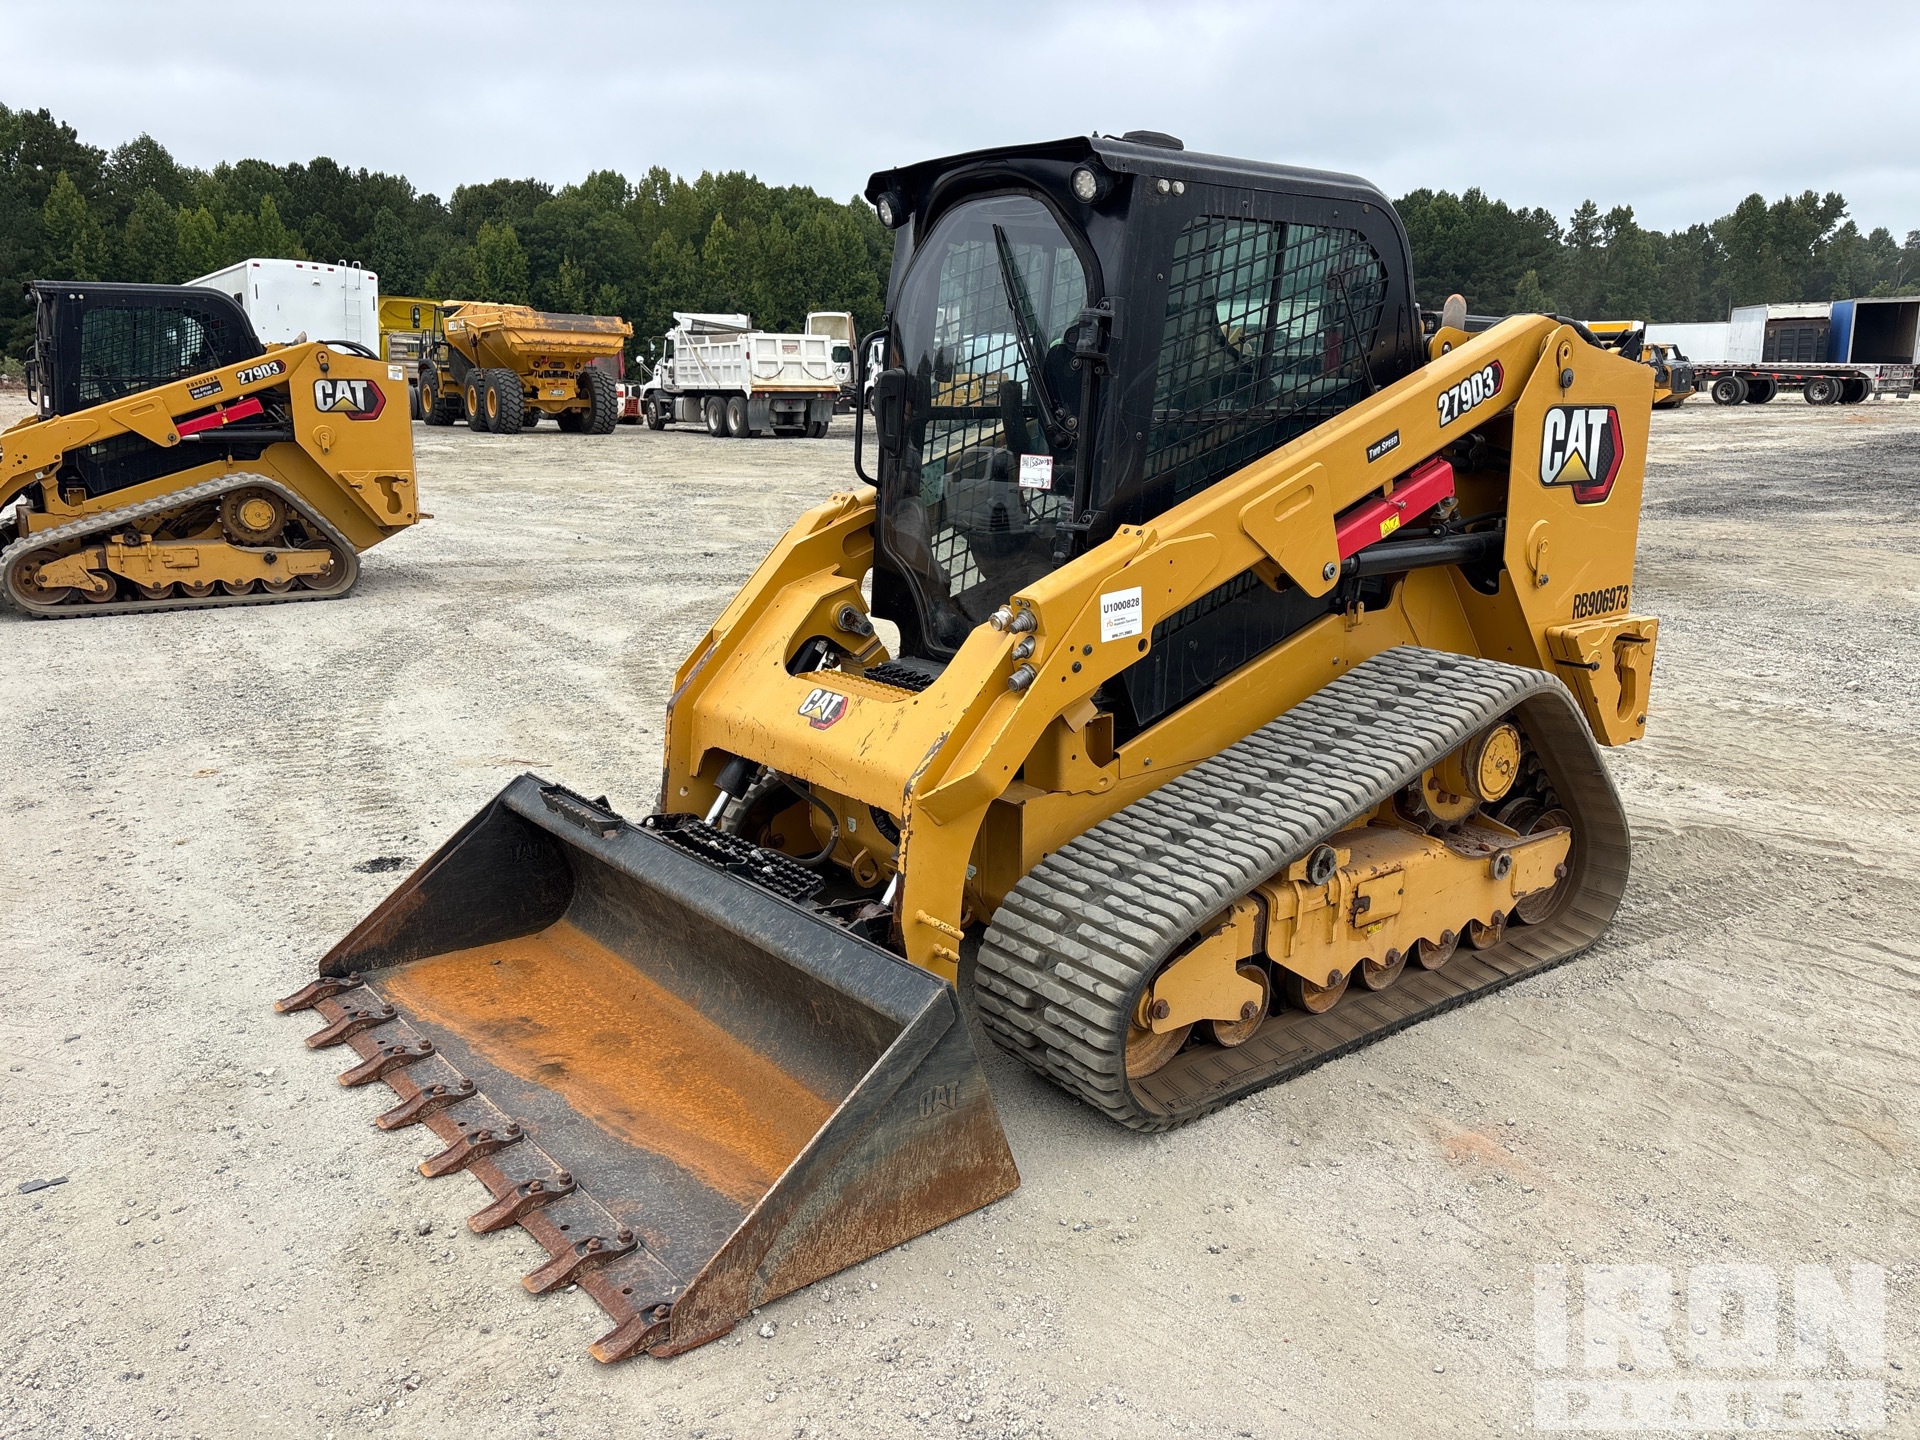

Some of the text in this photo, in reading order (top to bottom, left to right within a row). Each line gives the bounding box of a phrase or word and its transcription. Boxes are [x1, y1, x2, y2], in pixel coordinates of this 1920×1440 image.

[237, 361, 280, 385] 279D3
[314, 379, 368, 412] CAT
[1438, 366, 1494, 427] 279D3
[1541, 407, 1609, 484] CAT
[1103, 597, 1140, 614] U1000828
[1572, 584, 1629, 620] RB906973
[798, 688, 844, 721] CAT
